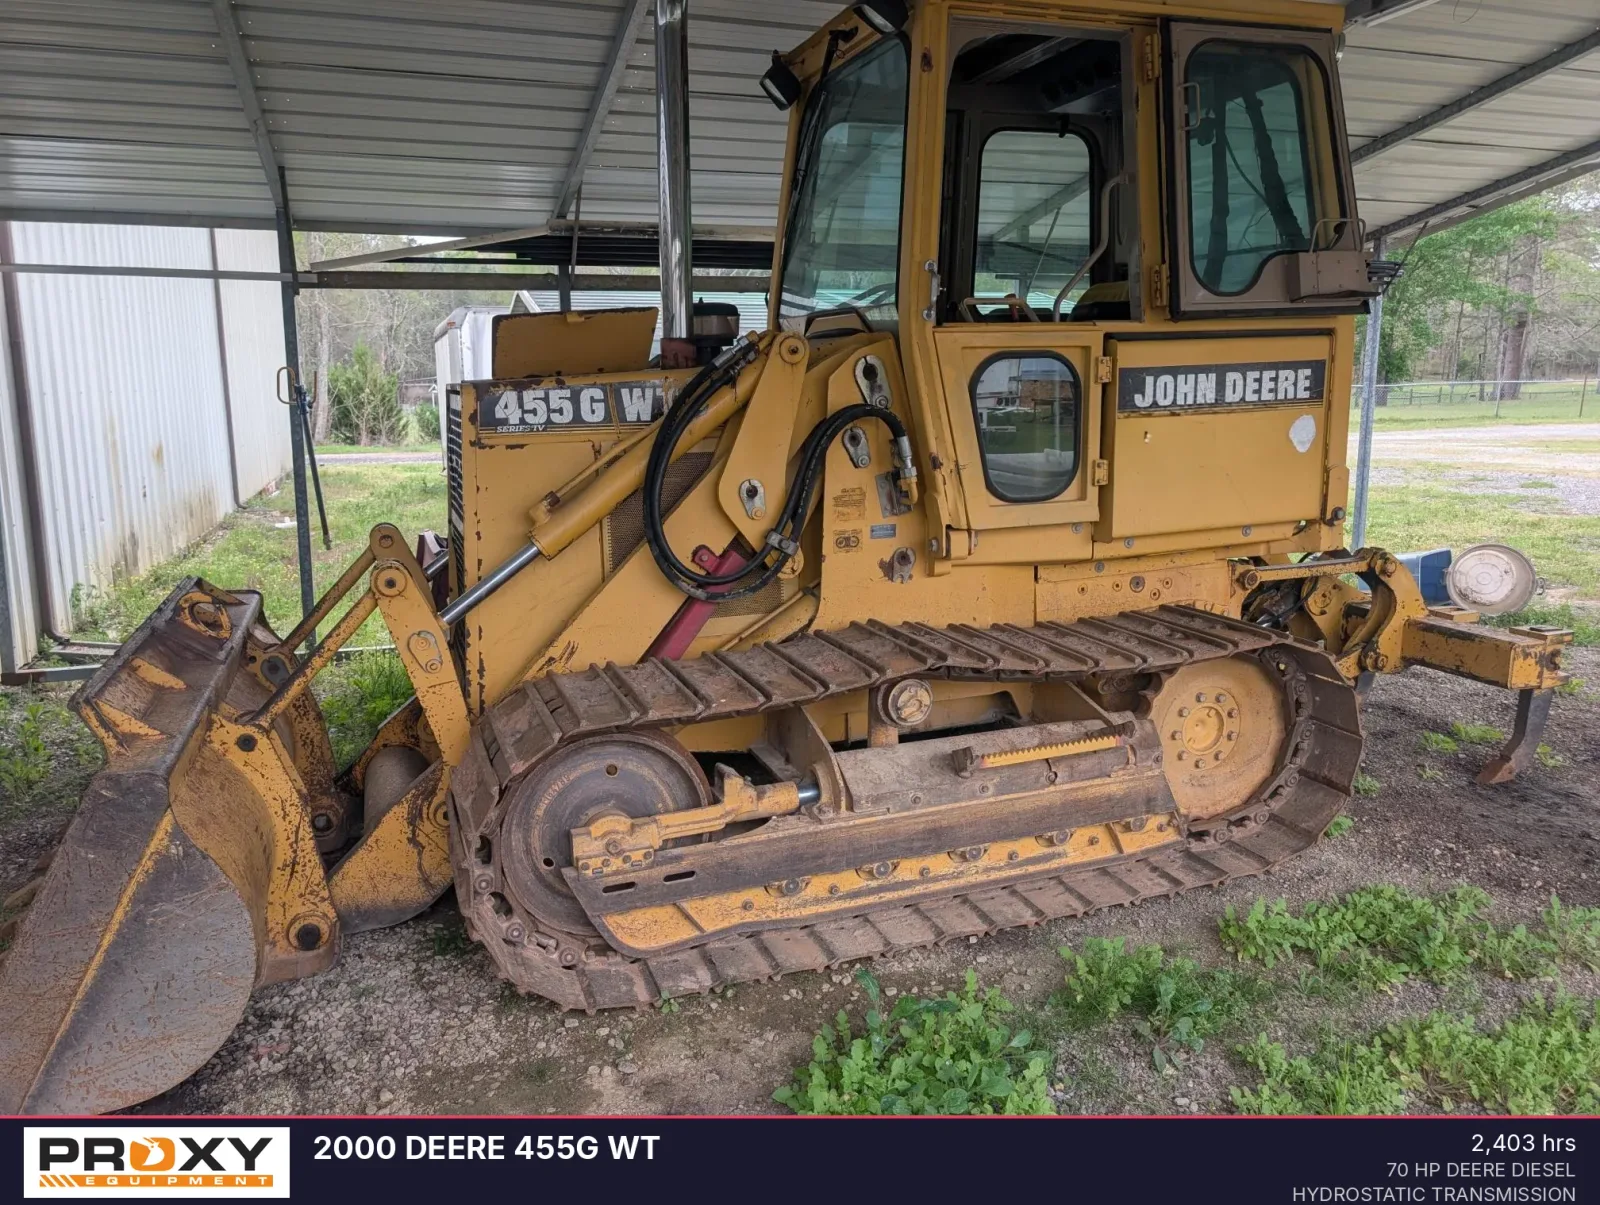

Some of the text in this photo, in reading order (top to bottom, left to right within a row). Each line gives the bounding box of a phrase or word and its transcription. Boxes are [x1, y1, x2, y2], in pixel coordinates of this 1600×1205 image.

[494, 387, 574, 425] 455
[580, 387, 605, 423] G
[1134, 368, 1312, 408] JOHN DEERE
[496, 425, 531, 433] SERIES
